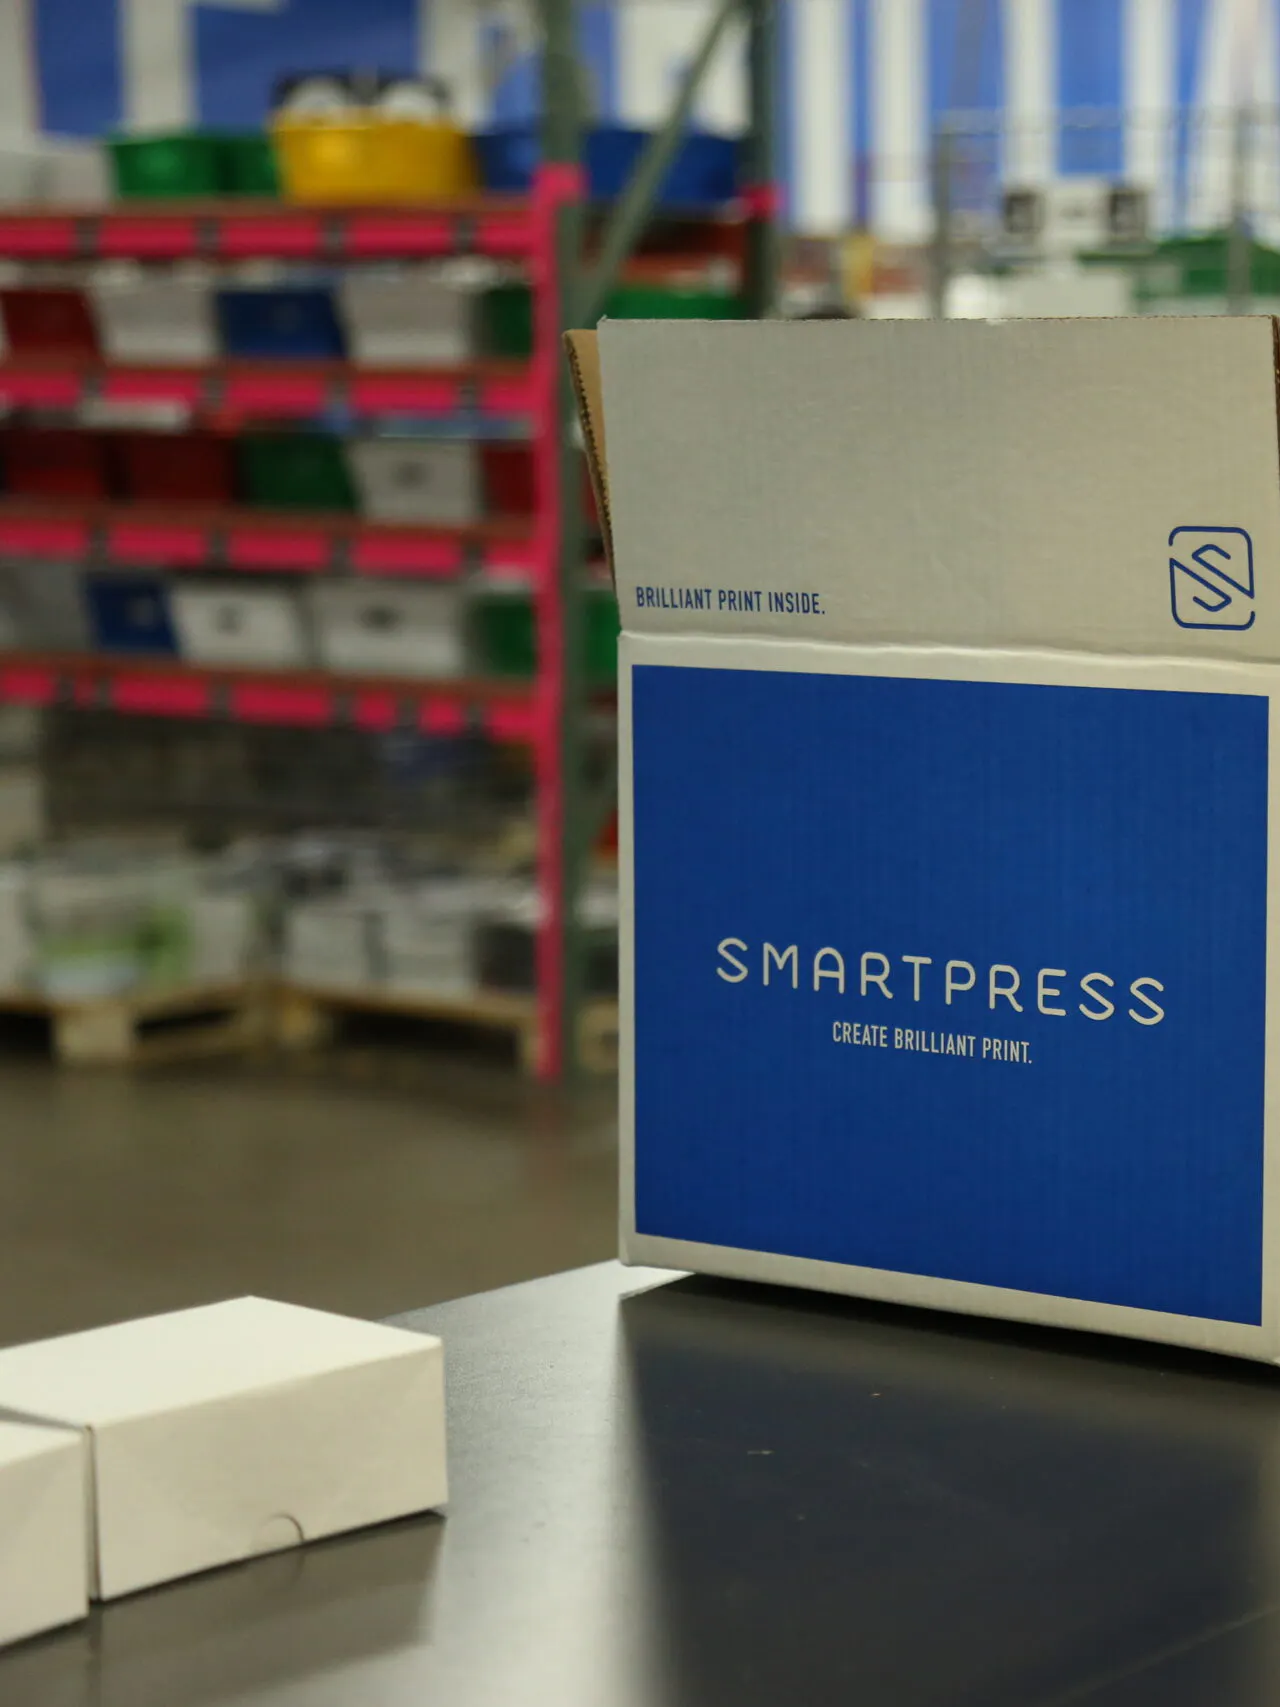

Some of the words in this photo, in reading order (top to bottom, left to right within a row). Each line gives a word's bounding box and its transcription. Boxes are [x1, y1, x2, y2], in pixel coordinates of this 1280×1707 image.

[636, 586, 712, 609] BRILLIANT
[718, 589, 762, 612] PRINT
[768, 591, 826, 615] INSIDE.
[716, 937, 1165, 1026] SMARTPRESS
[832, 1021, 888, 1048] CREATE
[894, 1028, 976, 1057] BRILLIANT
[982, 1040, 1033, 1064] PRINT.
